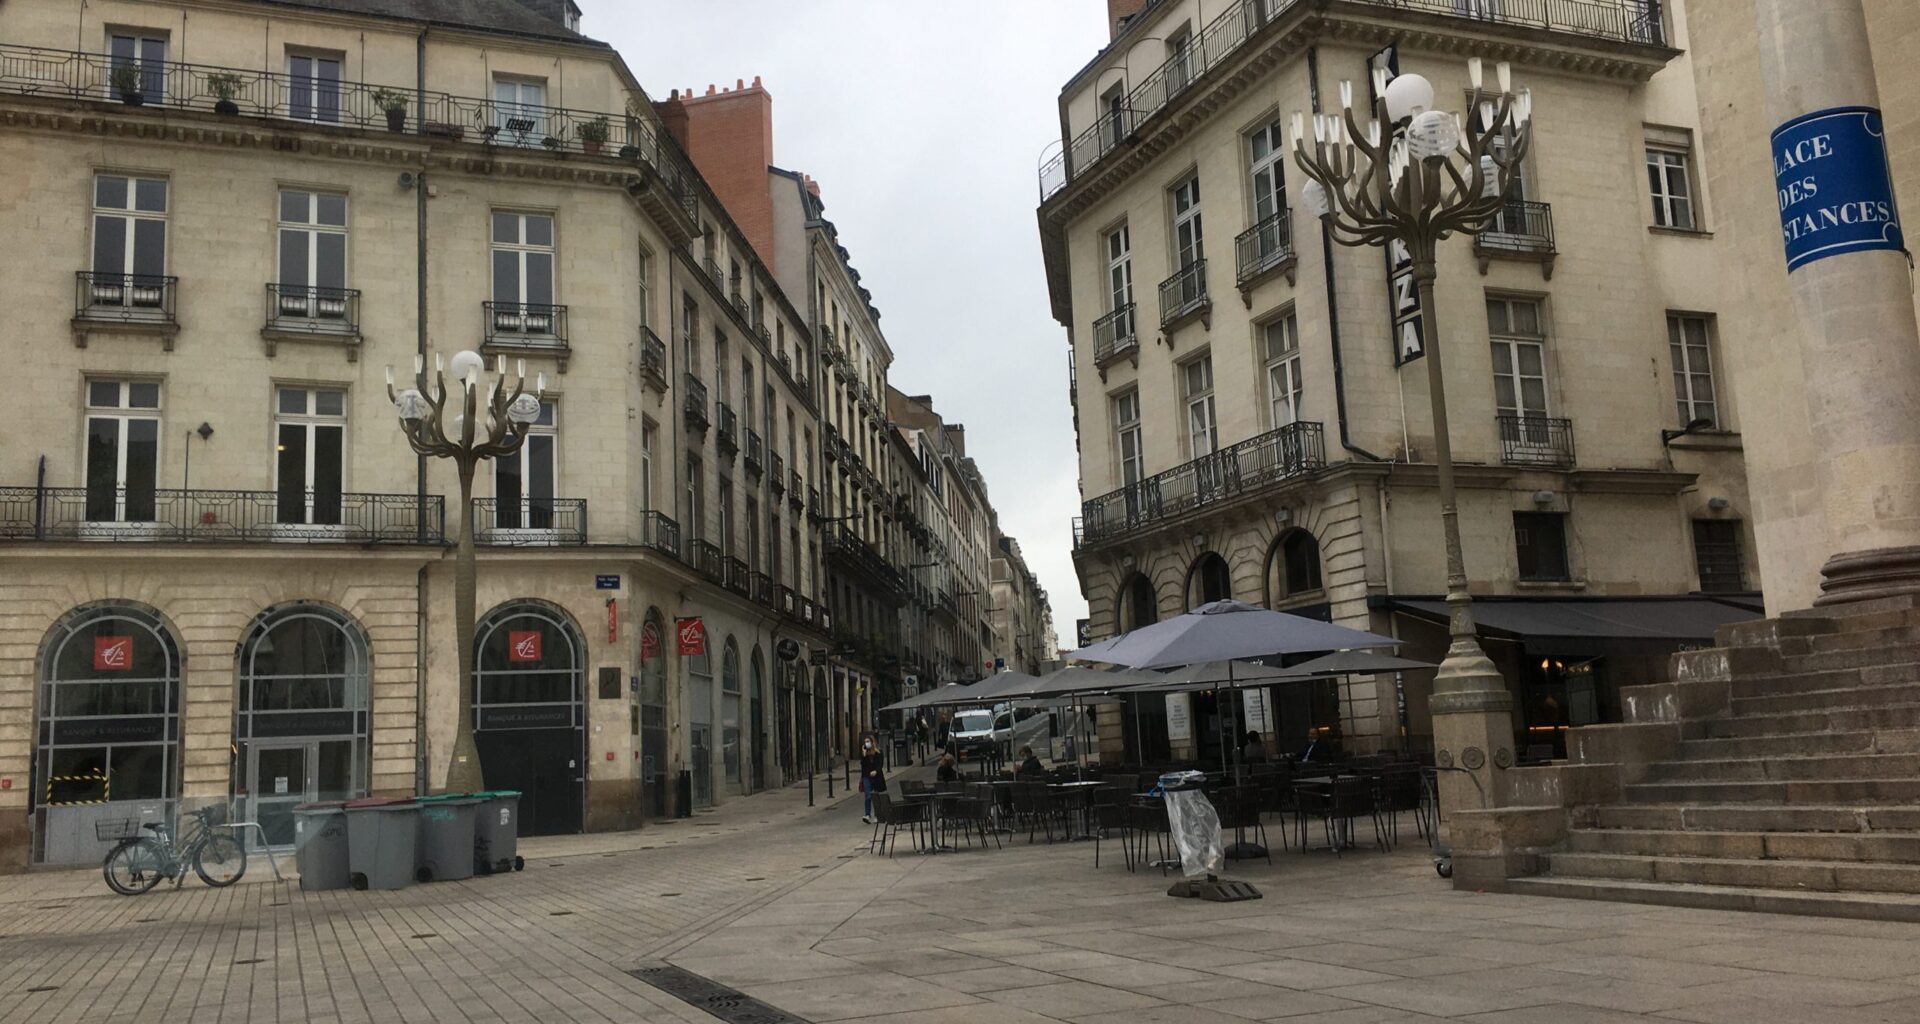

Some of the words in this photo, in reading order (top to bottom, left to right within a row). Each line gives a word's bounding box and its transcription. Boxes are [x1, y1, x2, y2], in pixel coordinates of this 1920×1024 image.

[1774, 134, 1833, 177] LACE
[1373, 47, 1421, 357] KRZA
[1779, 176, 1818, 212] DES
[1784, 201, 1890, 245] STANCES
